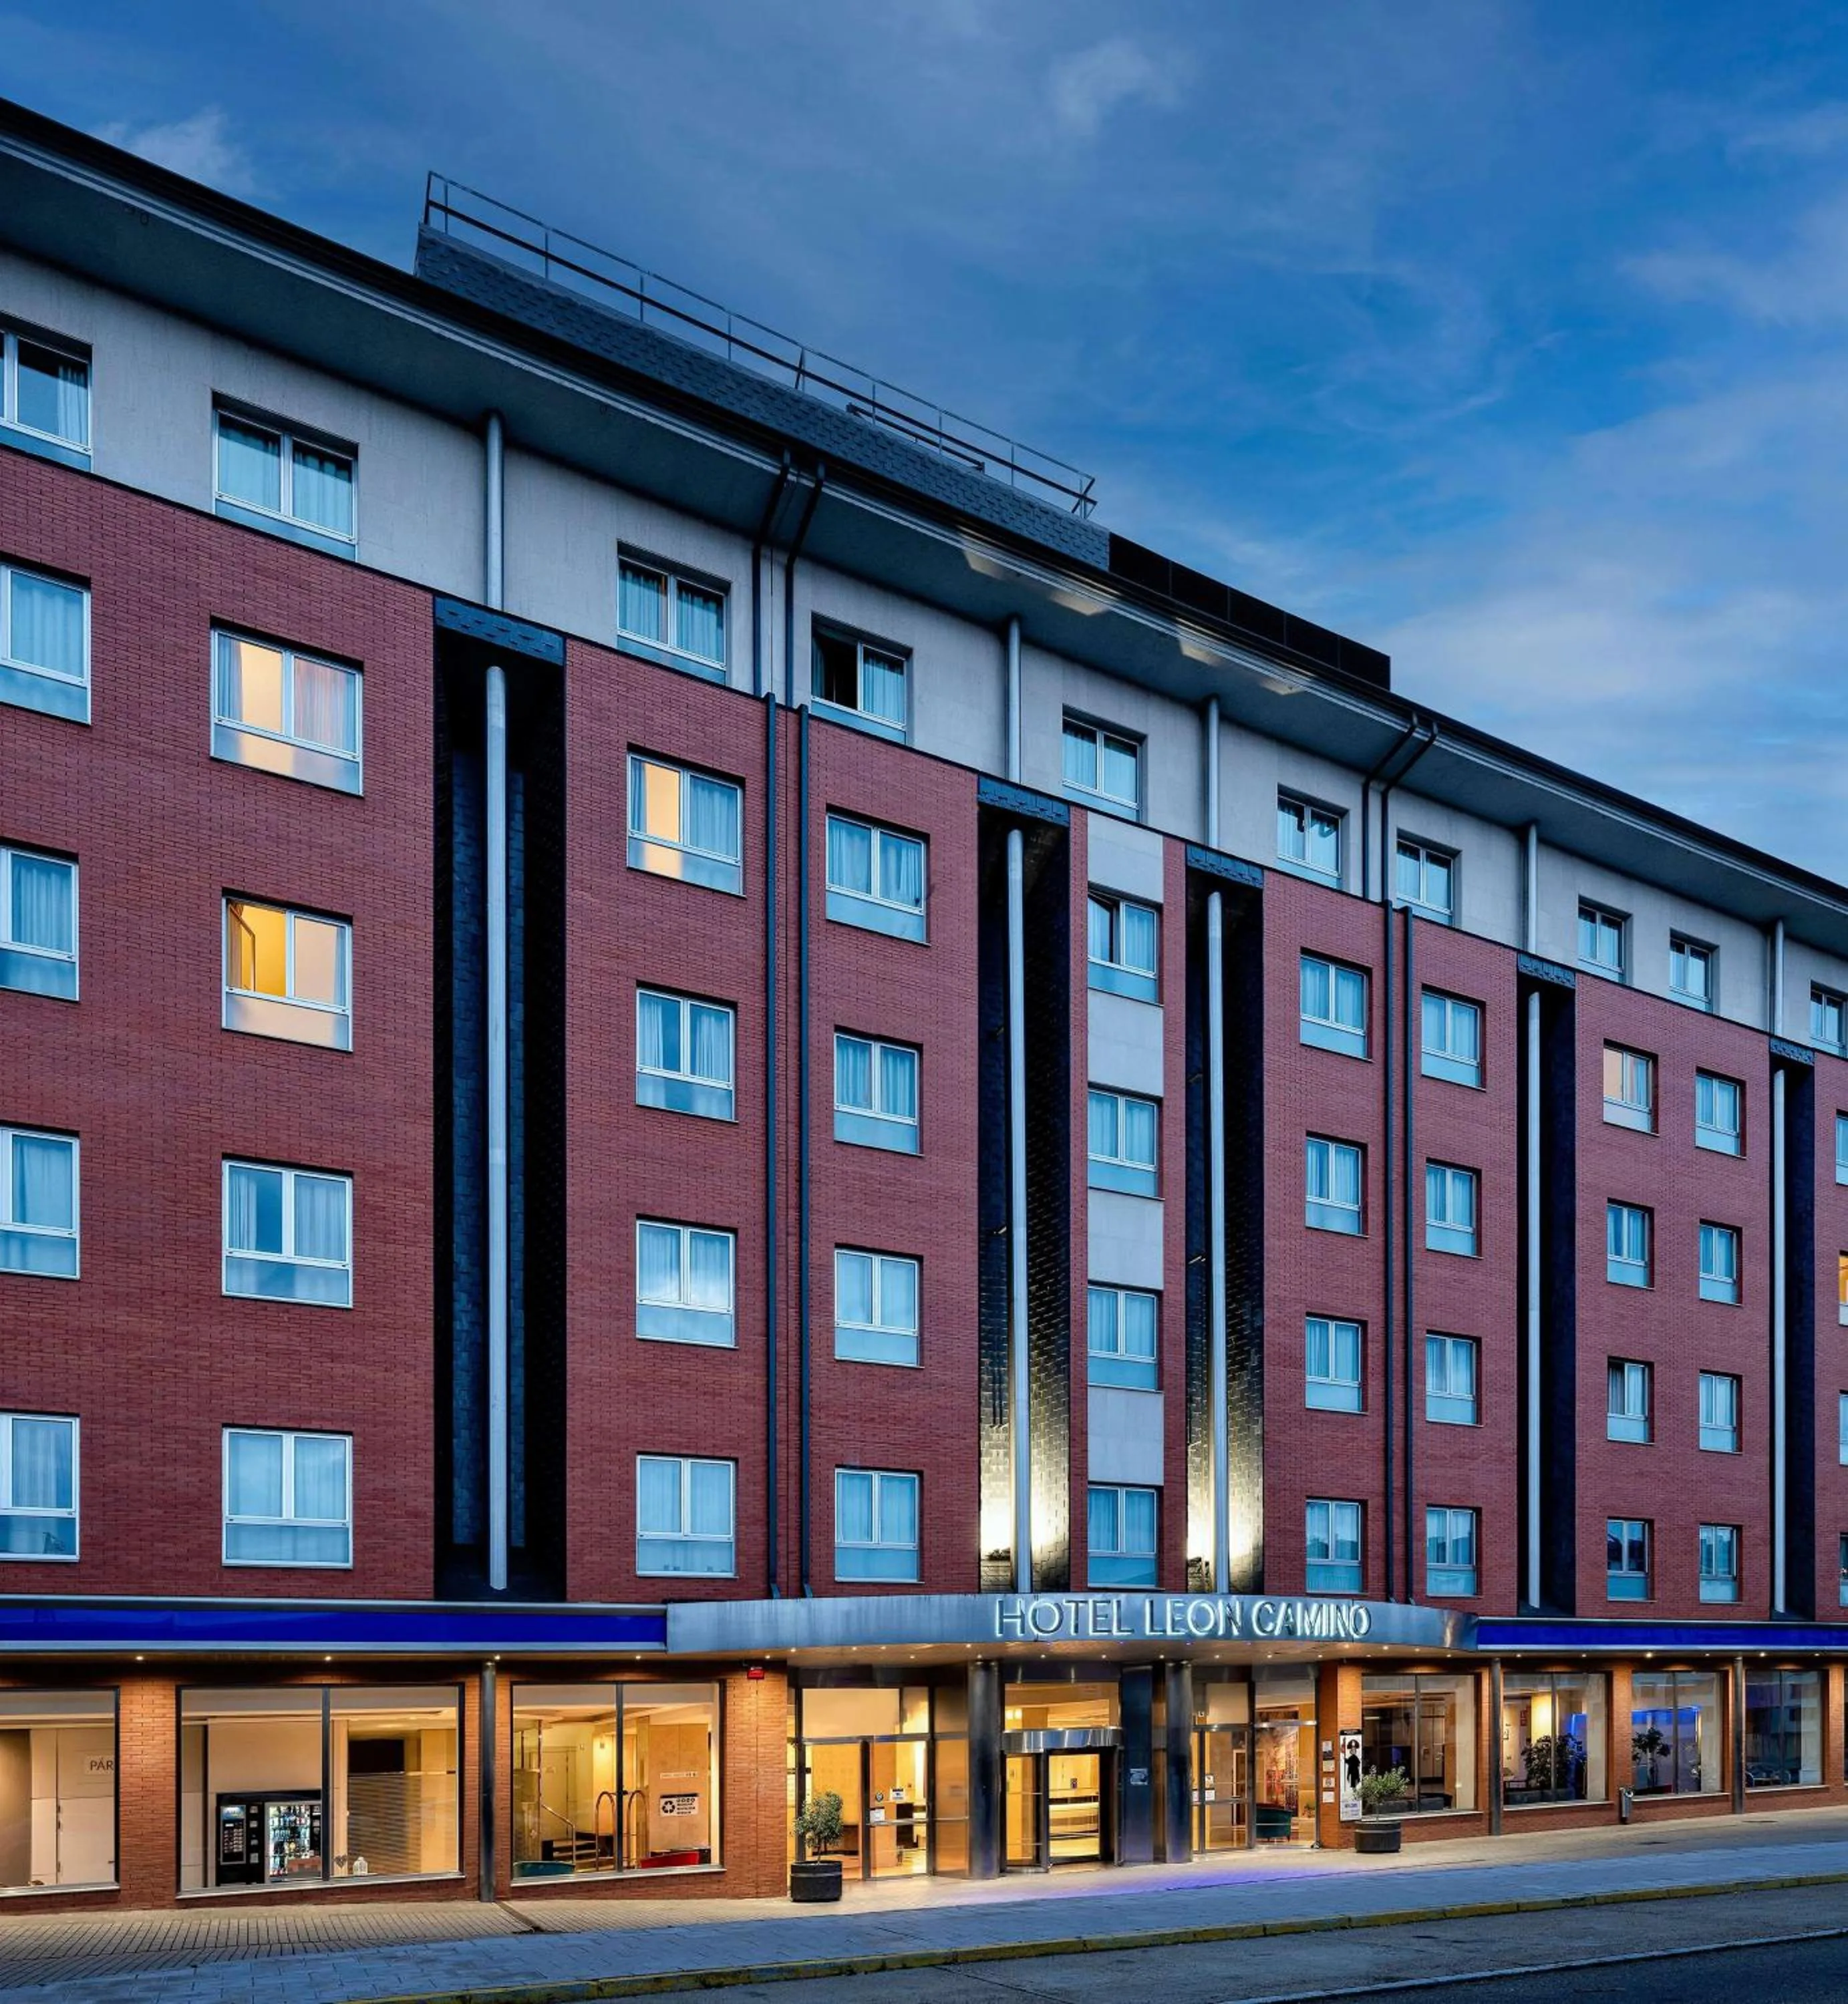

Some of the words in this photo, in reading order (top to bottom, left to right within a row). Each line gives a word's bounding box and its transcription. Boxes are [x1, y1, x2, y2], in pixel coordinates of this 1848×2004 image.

[995, 1598, 1134, 1637] HOTEL
[1144, 1599, 1241, 1637] LEON
[1251, 1600, 1371, 1638] CAMINO
